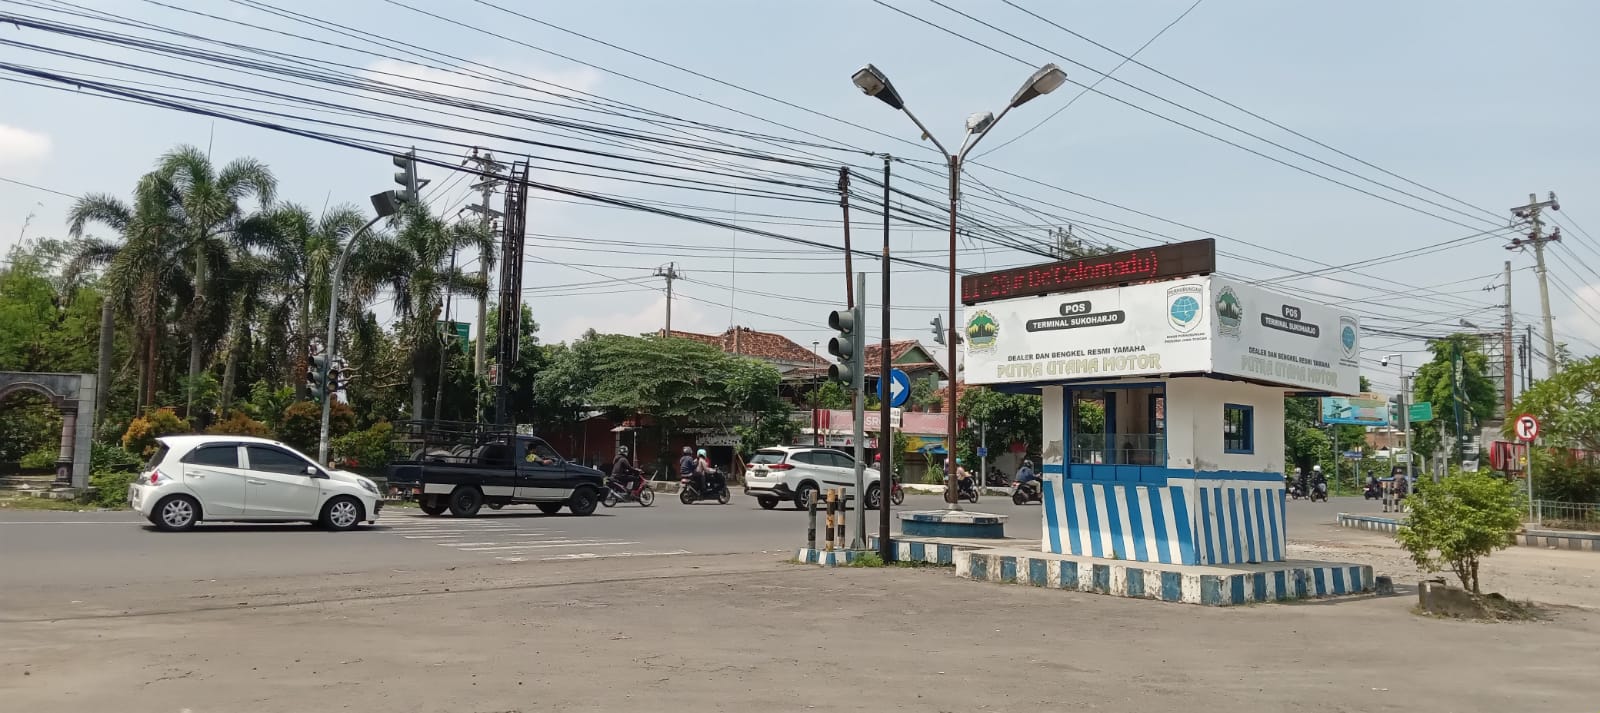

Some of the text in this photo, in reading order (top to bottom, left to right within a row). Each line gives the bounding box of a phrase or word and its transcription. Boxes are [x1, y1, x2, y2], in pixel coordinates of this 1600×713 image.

[1065, 303, 1085, 314] POS
[1285, 307, 1298, 318] POS
[1032, 314, 1118, 329] TERMINAL SUKOHARJO
[1265, 317, 1289, 328] TERMINAL
[1008, 354, 1034, 362] DEALER
[1052, 350, 1085, 359] BENGKEL
[1087, 347, 1111, 356] RESMI
[1113, 345, 1146, 353] YAMAHA
[1248, 346, 1267, 356] DEALER
[1267, 350, 1278, 358] DAN
[997, 353, 1162, 378] PUTRA UTAMA MOTOR
